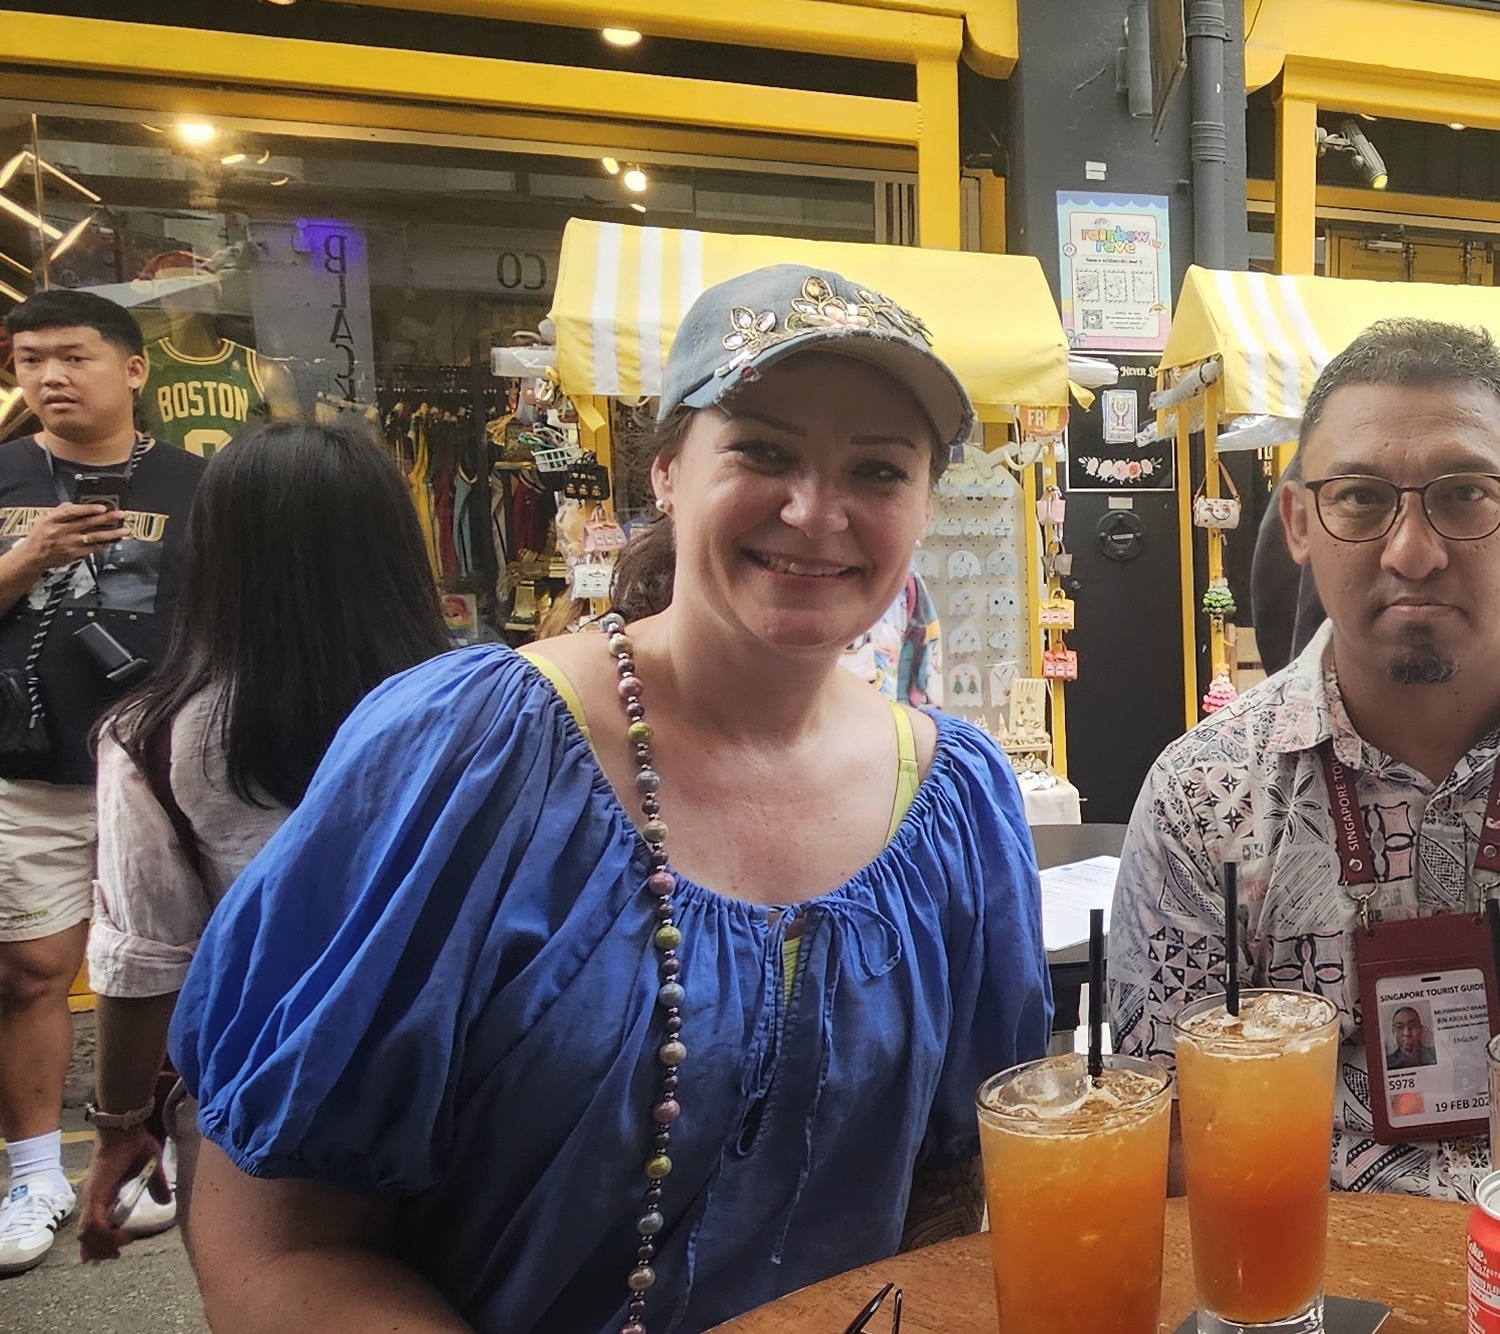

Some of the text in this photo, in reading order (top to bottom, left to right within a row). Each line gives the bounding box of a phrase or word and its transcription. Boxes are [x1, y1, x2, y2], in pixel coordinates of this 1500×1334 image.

[1082, 225, 1150, 244] rainbow
[1096, 241, 1136, 255] rave
[157, 380, 249, 424] BOSTON
[1336, 783, 1359, 851] SINGAPORE
[1380, 982, 1485, 1003] SINGAPORE TOURIST GUIDE
[1388, 1078, 1415, 1091] 5978
[1435, 1101, 1448, 1113] 19
[1450, 1098, 1470, 1110] FEB
